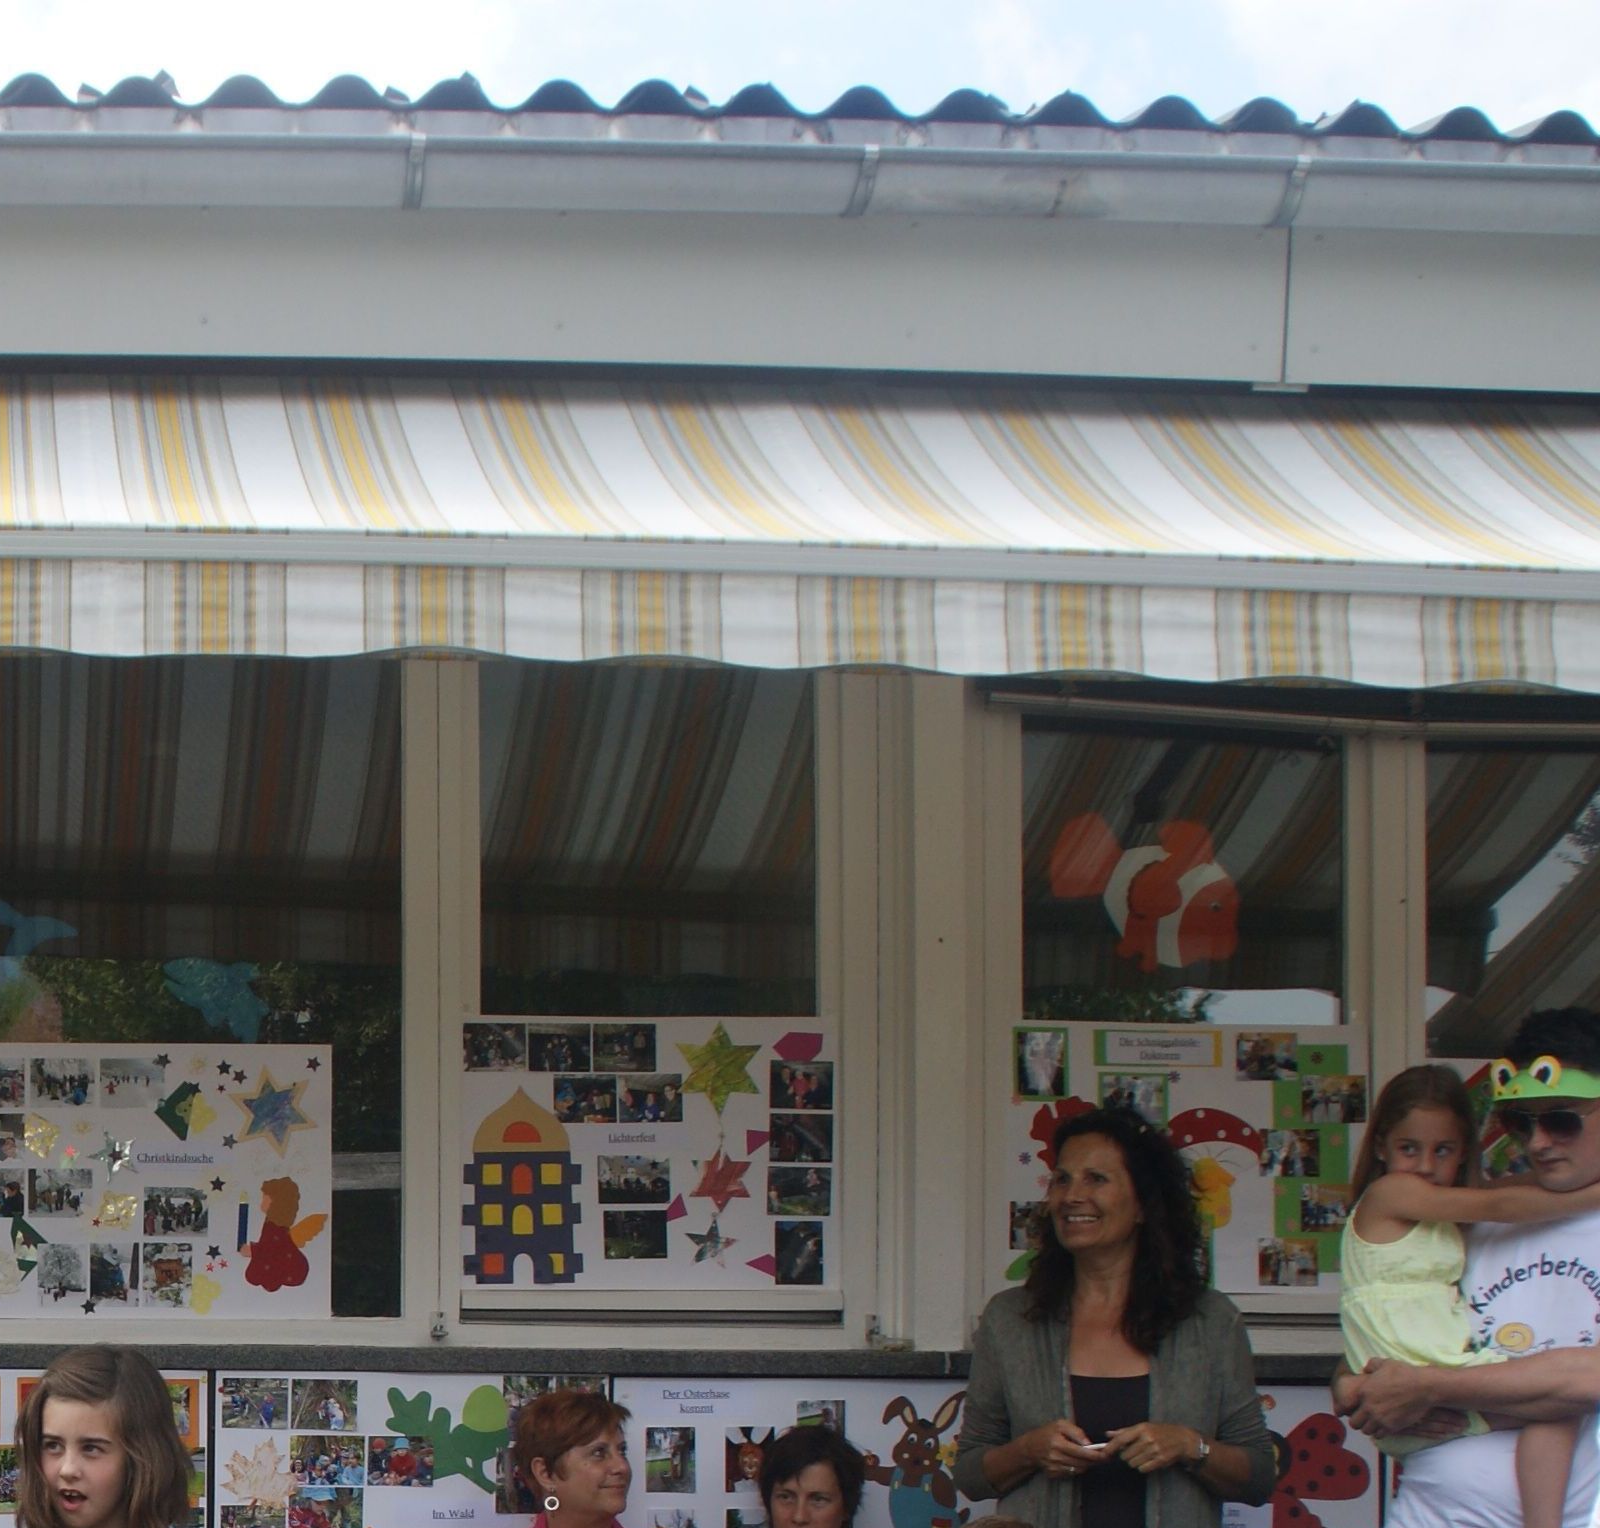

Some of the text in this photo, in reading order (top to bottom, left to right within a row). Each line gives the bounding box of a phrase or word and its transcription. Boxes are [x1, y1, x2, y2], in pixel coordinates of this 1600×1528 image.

[608, 1132, 656, 1143] Lichterfest
[136, 1152, 214, 1164] Christkindsuche
[663, 1388, 731, 1400] Der Osterhase
[679, 1402, 714, 1414] kommt
[432, 1508, 474, 1519] Im Wald
